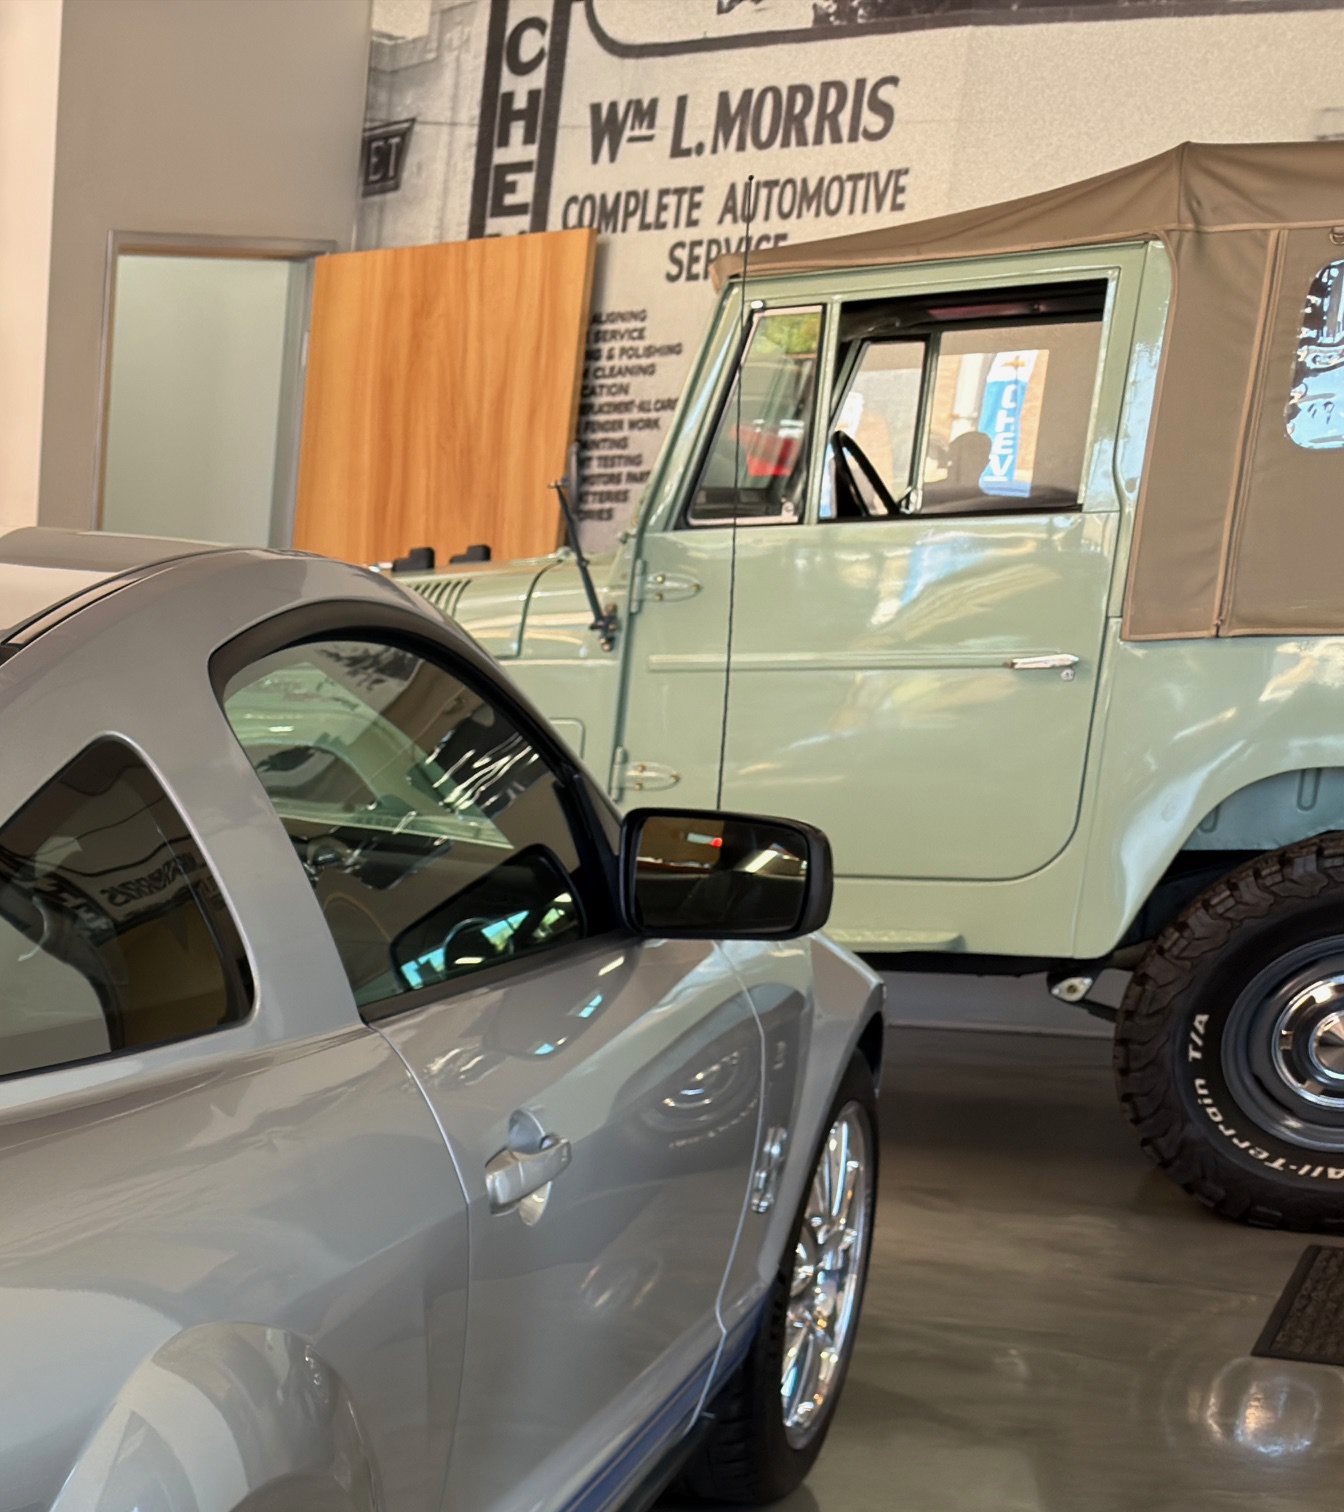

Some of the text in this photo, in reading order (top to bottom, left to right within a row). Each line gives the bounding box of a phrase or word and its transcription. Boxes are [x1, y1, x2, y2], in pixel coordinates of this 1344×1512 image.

[488, 16, 548, 239] CHE
[710, 75, 900, 155] MORRIS
[562, 167, 911, 234] COMPLETE AUTOMOTIVE
[593, 326, 647, 343] SERVICE
[618, 342, 683, 359] POLISHING
[592, 363, 657, 379] CLEANING
[627, 418, 661, 431] WORK
[1188, 1013, 1210, 1063] T/A
